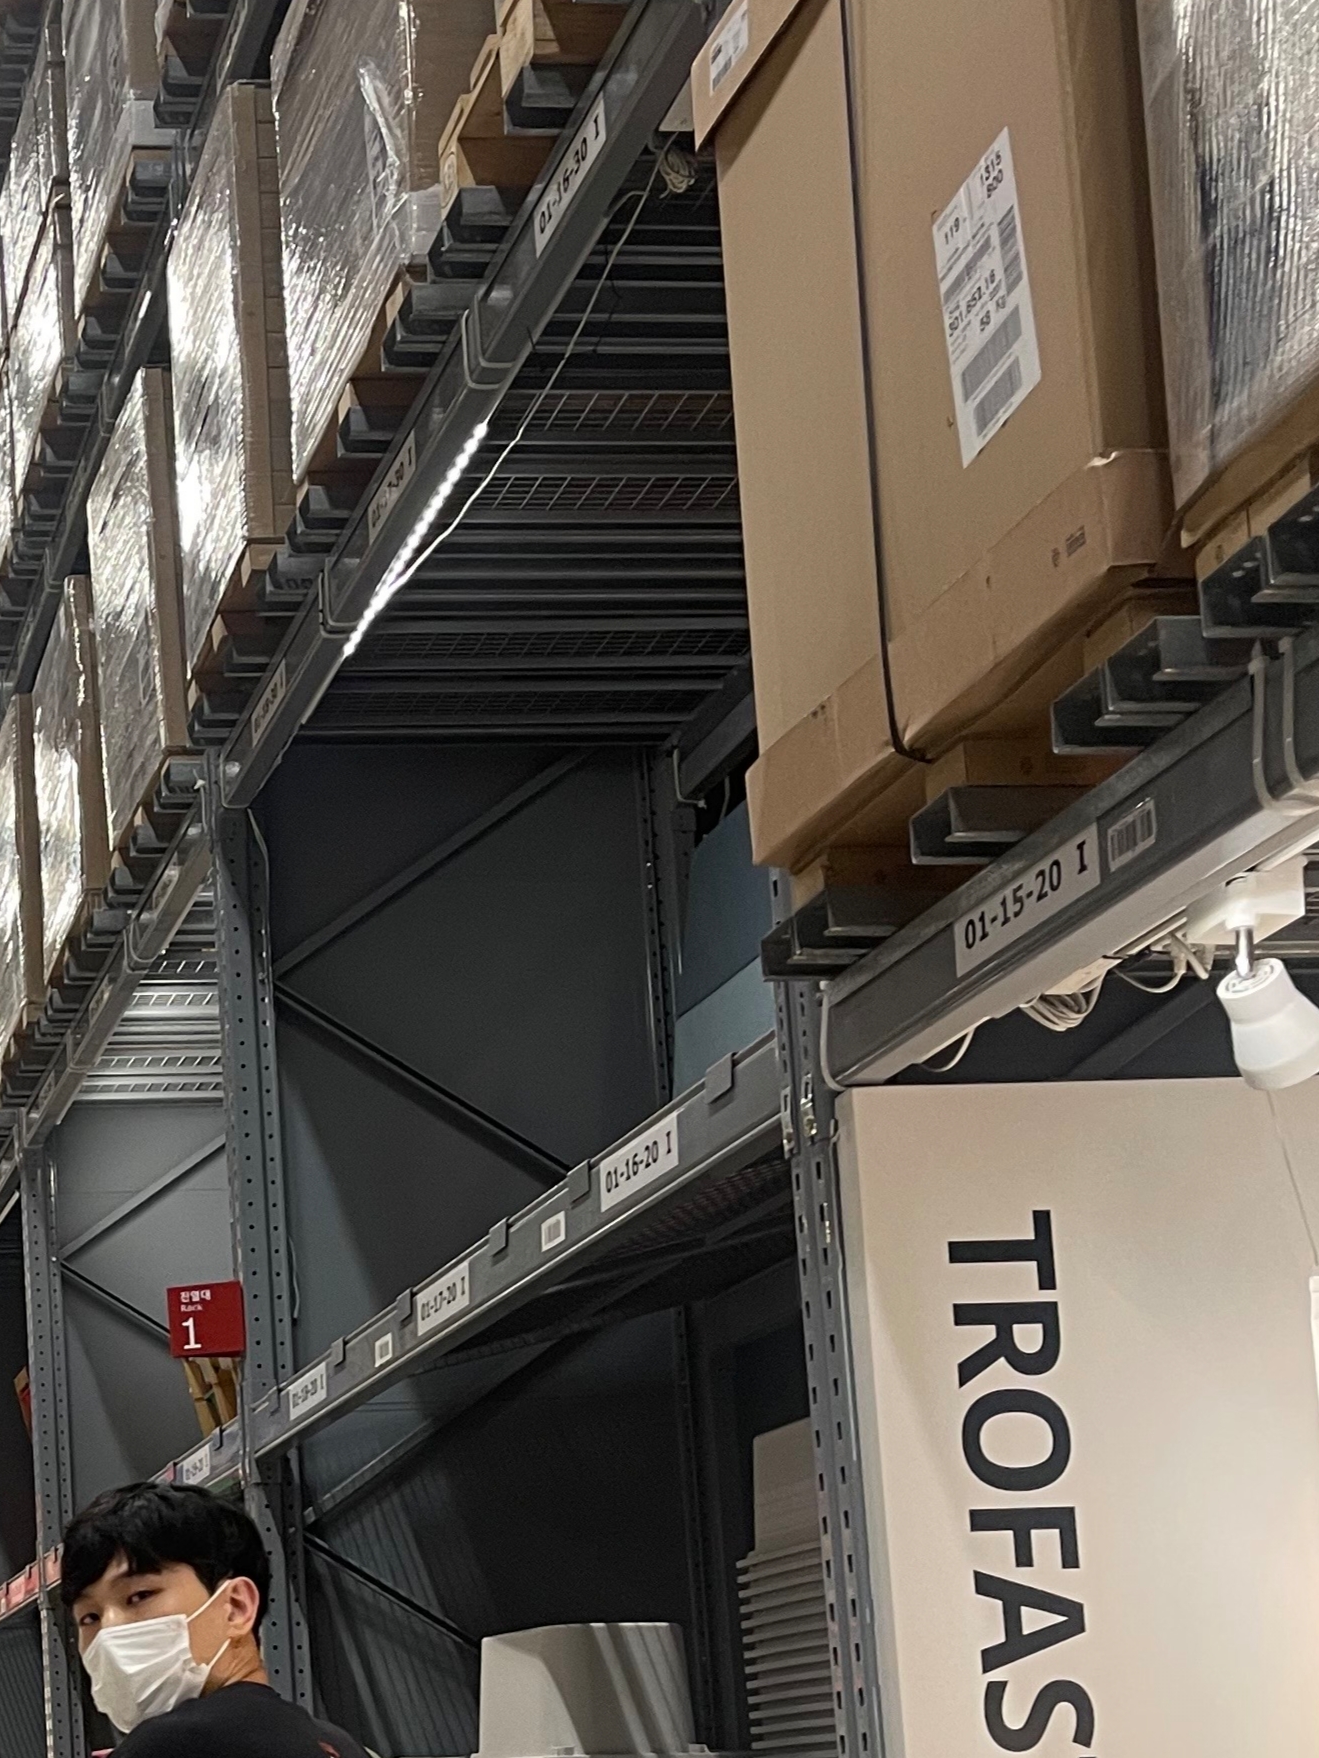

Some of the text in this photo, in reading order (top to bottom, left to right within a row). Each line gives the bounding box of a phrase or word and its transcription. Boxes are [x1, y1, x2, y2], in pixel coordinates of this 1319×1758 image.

[964, 859, 1063, 950] 01-15-20
[604, 1139, 660, 1194] 01-16-20
[182, 1317, 202, 1350] 1
